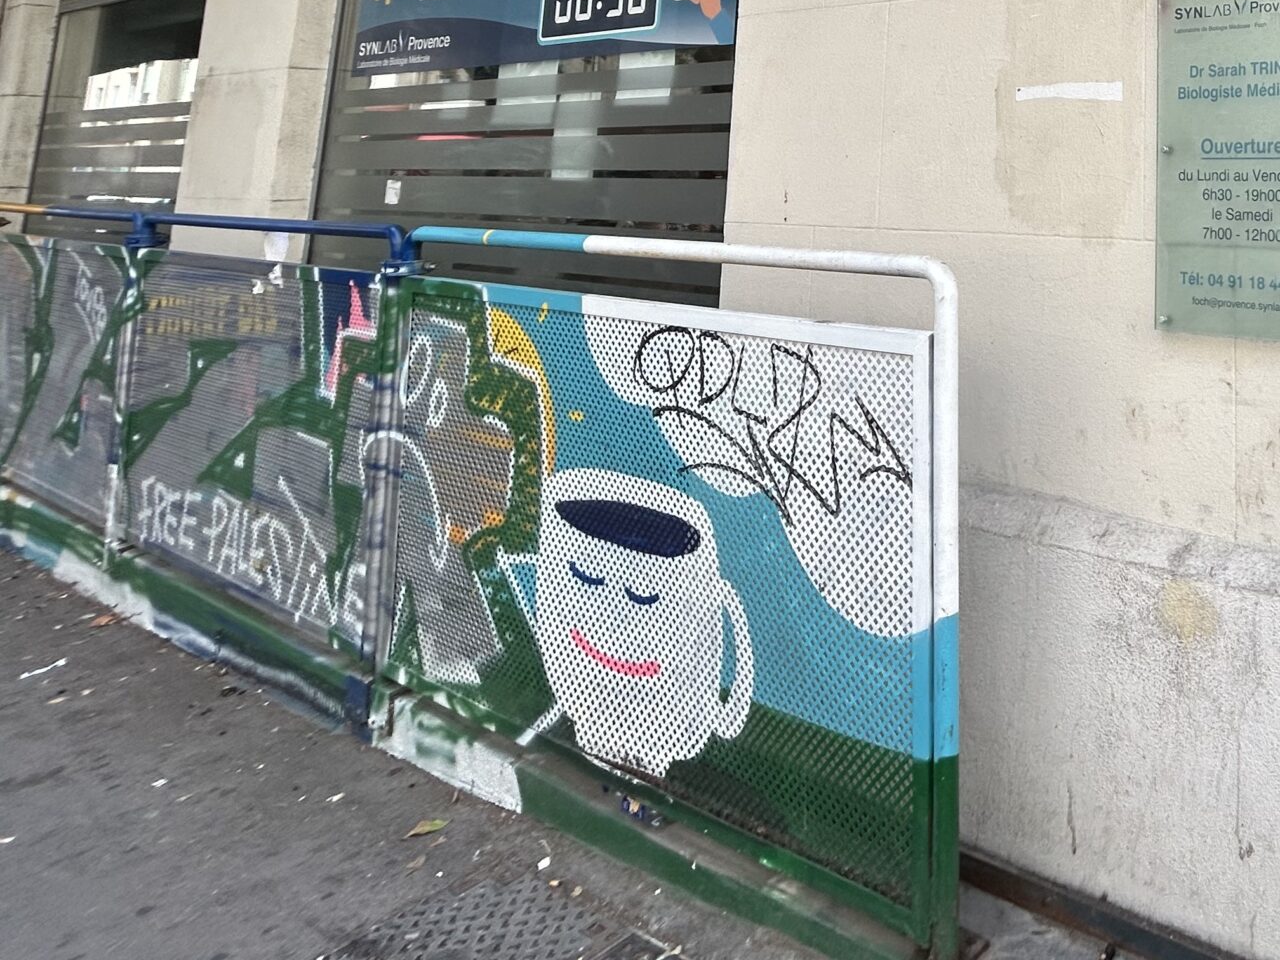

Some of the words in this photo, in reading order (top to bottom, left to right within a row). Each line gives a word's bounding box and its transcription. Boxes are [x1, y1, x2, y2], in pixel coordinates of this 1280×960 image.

[1174, 3, 1232, 20] SYNLAB
[359, 38, 397, 56] SYNLAB
[408, 35, 451, 51] Provence
[1189, 65, 1204, 78] Dr
[1208, 62, 1246, 78] Sarah
[1177, 84, 1242, 102] Biologiste
[1178, 169, 1193, 182] du
[1197, 169, 1230, 182] Lundi
[1233, 172, 1249, 182] au
[1202, 188, 1232, 201] 6h30
[1212, 208, 1222, 220] le
[1226, 208, 1273, 222] Samedi
[1202, 227, 1232, 240] 7h00
[1180, 271, 1204, 286] Tél:
[1208, 274, 1223, 287] 04
[1228, 275, 1243, 288] 91
[1249, 276, 1265, 290] 18
[138, 475, 202, 551] FREE
